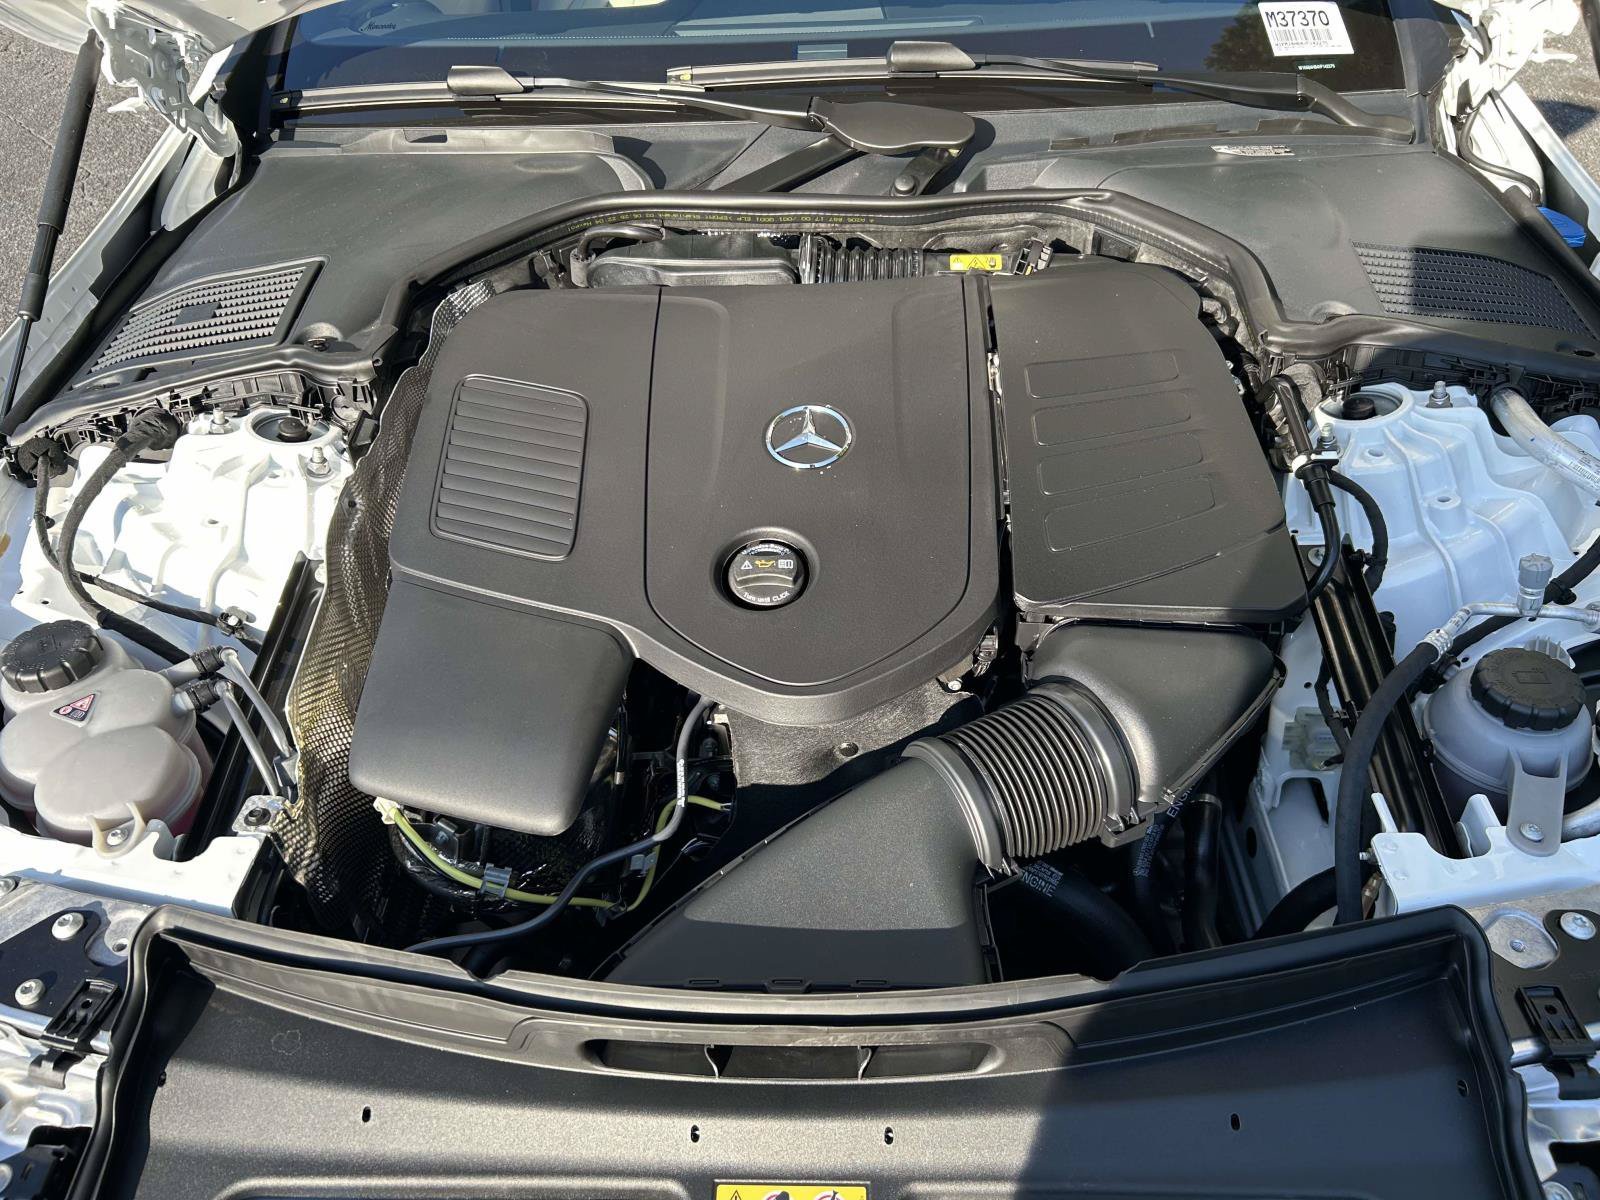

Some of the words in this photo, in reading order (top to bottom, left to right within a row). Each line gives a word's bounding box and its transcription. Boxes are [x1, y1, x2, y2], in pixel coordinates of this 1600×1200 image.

[1265, 10, 1329, 28] M37370
[743, 592, 756, 601] Turn
[772, 590, 790, 602] CLICK
[1021, 869, 1058, 897] NGINE
